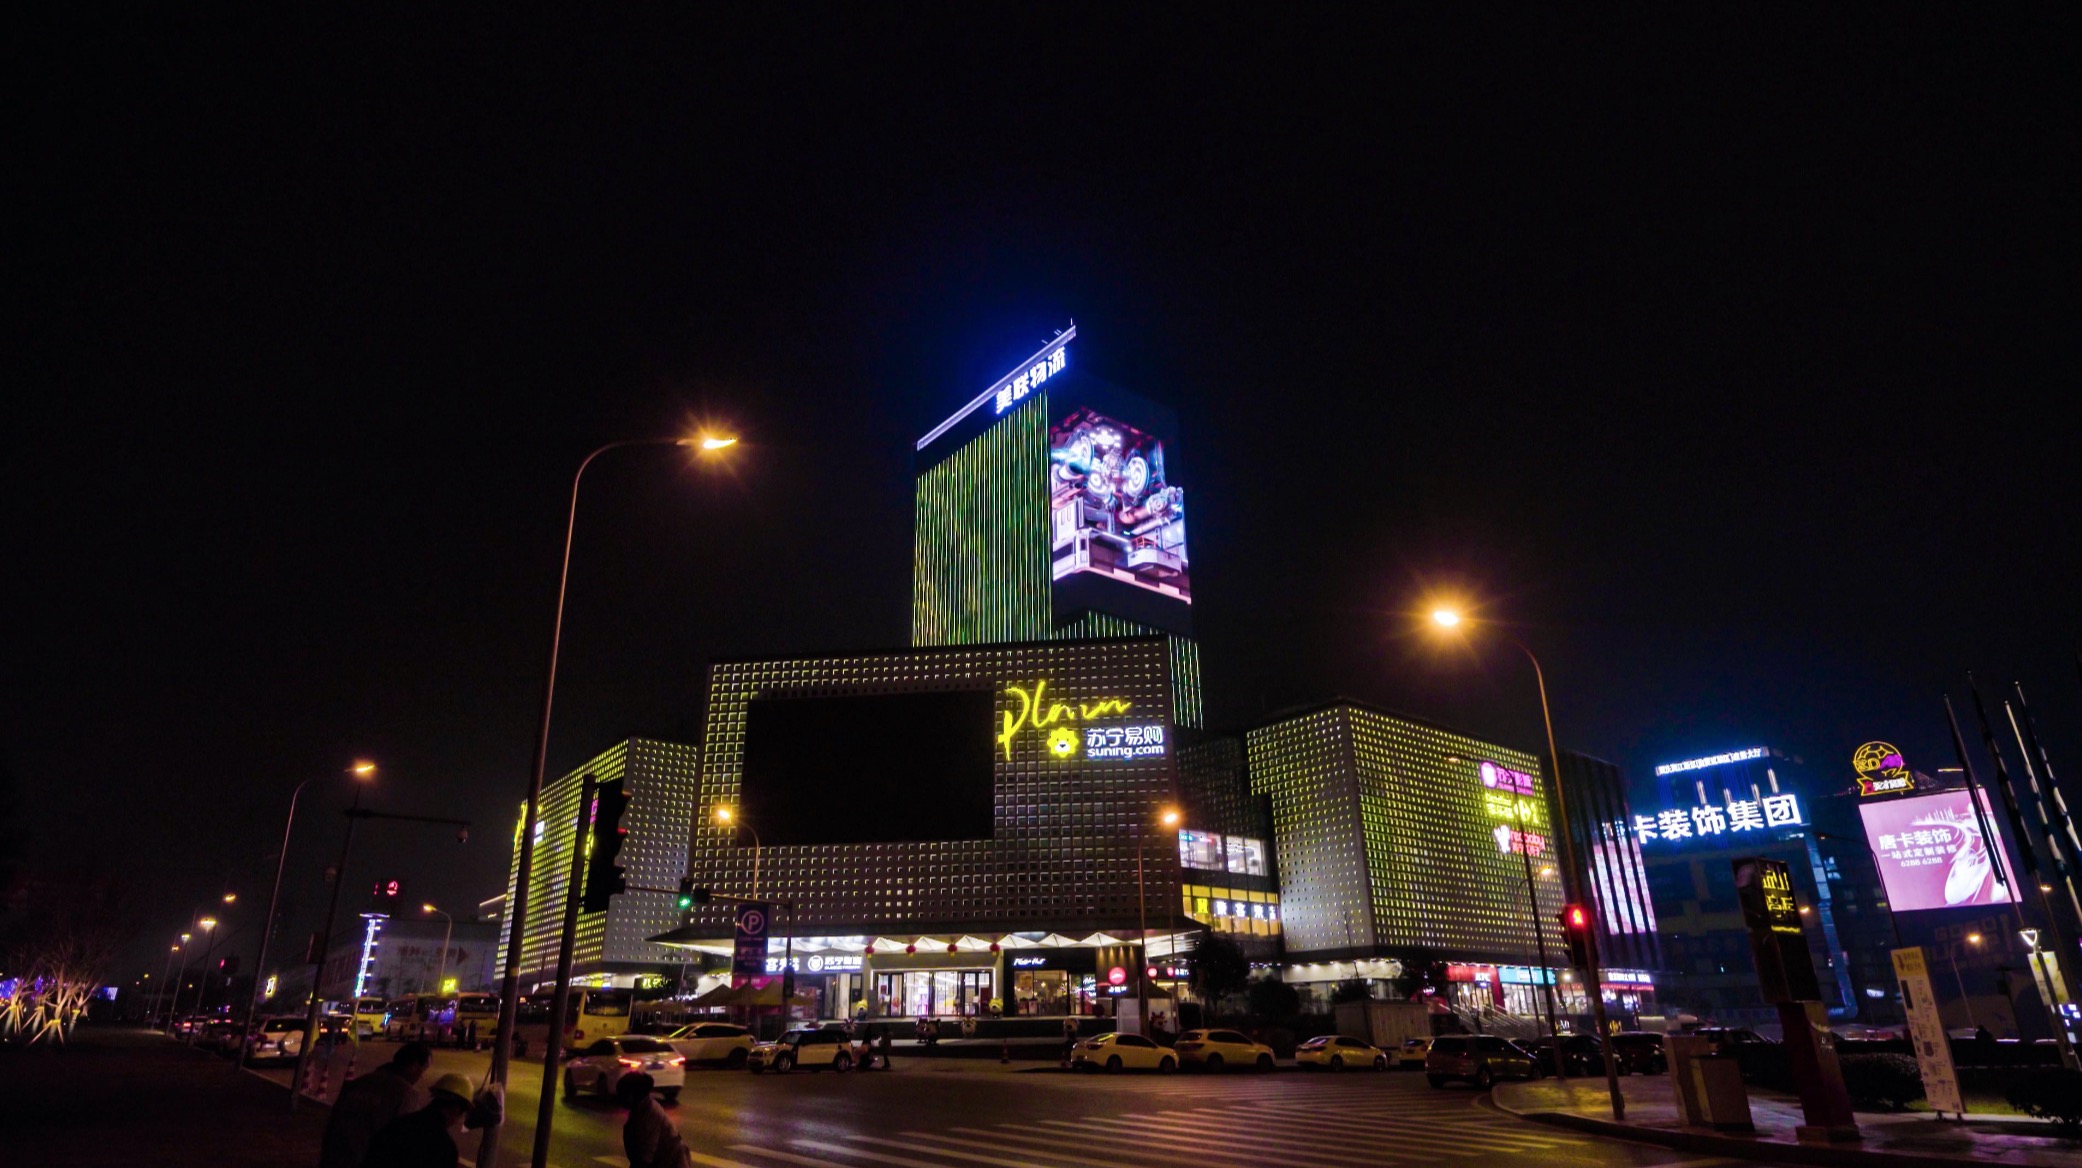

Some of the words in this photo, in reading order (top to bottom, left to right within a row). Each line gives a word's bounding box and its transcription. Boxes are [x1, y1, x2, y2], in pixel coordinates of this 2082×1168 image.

[996, 346, 1066, 414] 美联物流
[1087, 726, 1164, 747] 苏宁易购
[1087, 744, 1164, 759] suning.com
[1634, 794, 1802, 845] 卡装饰集团
[1878, 828, 1953, 851] 唐卡装饰
[1880, 844, 1957, 860] 一站式定制装修
[747, 915, 760, 931] P
